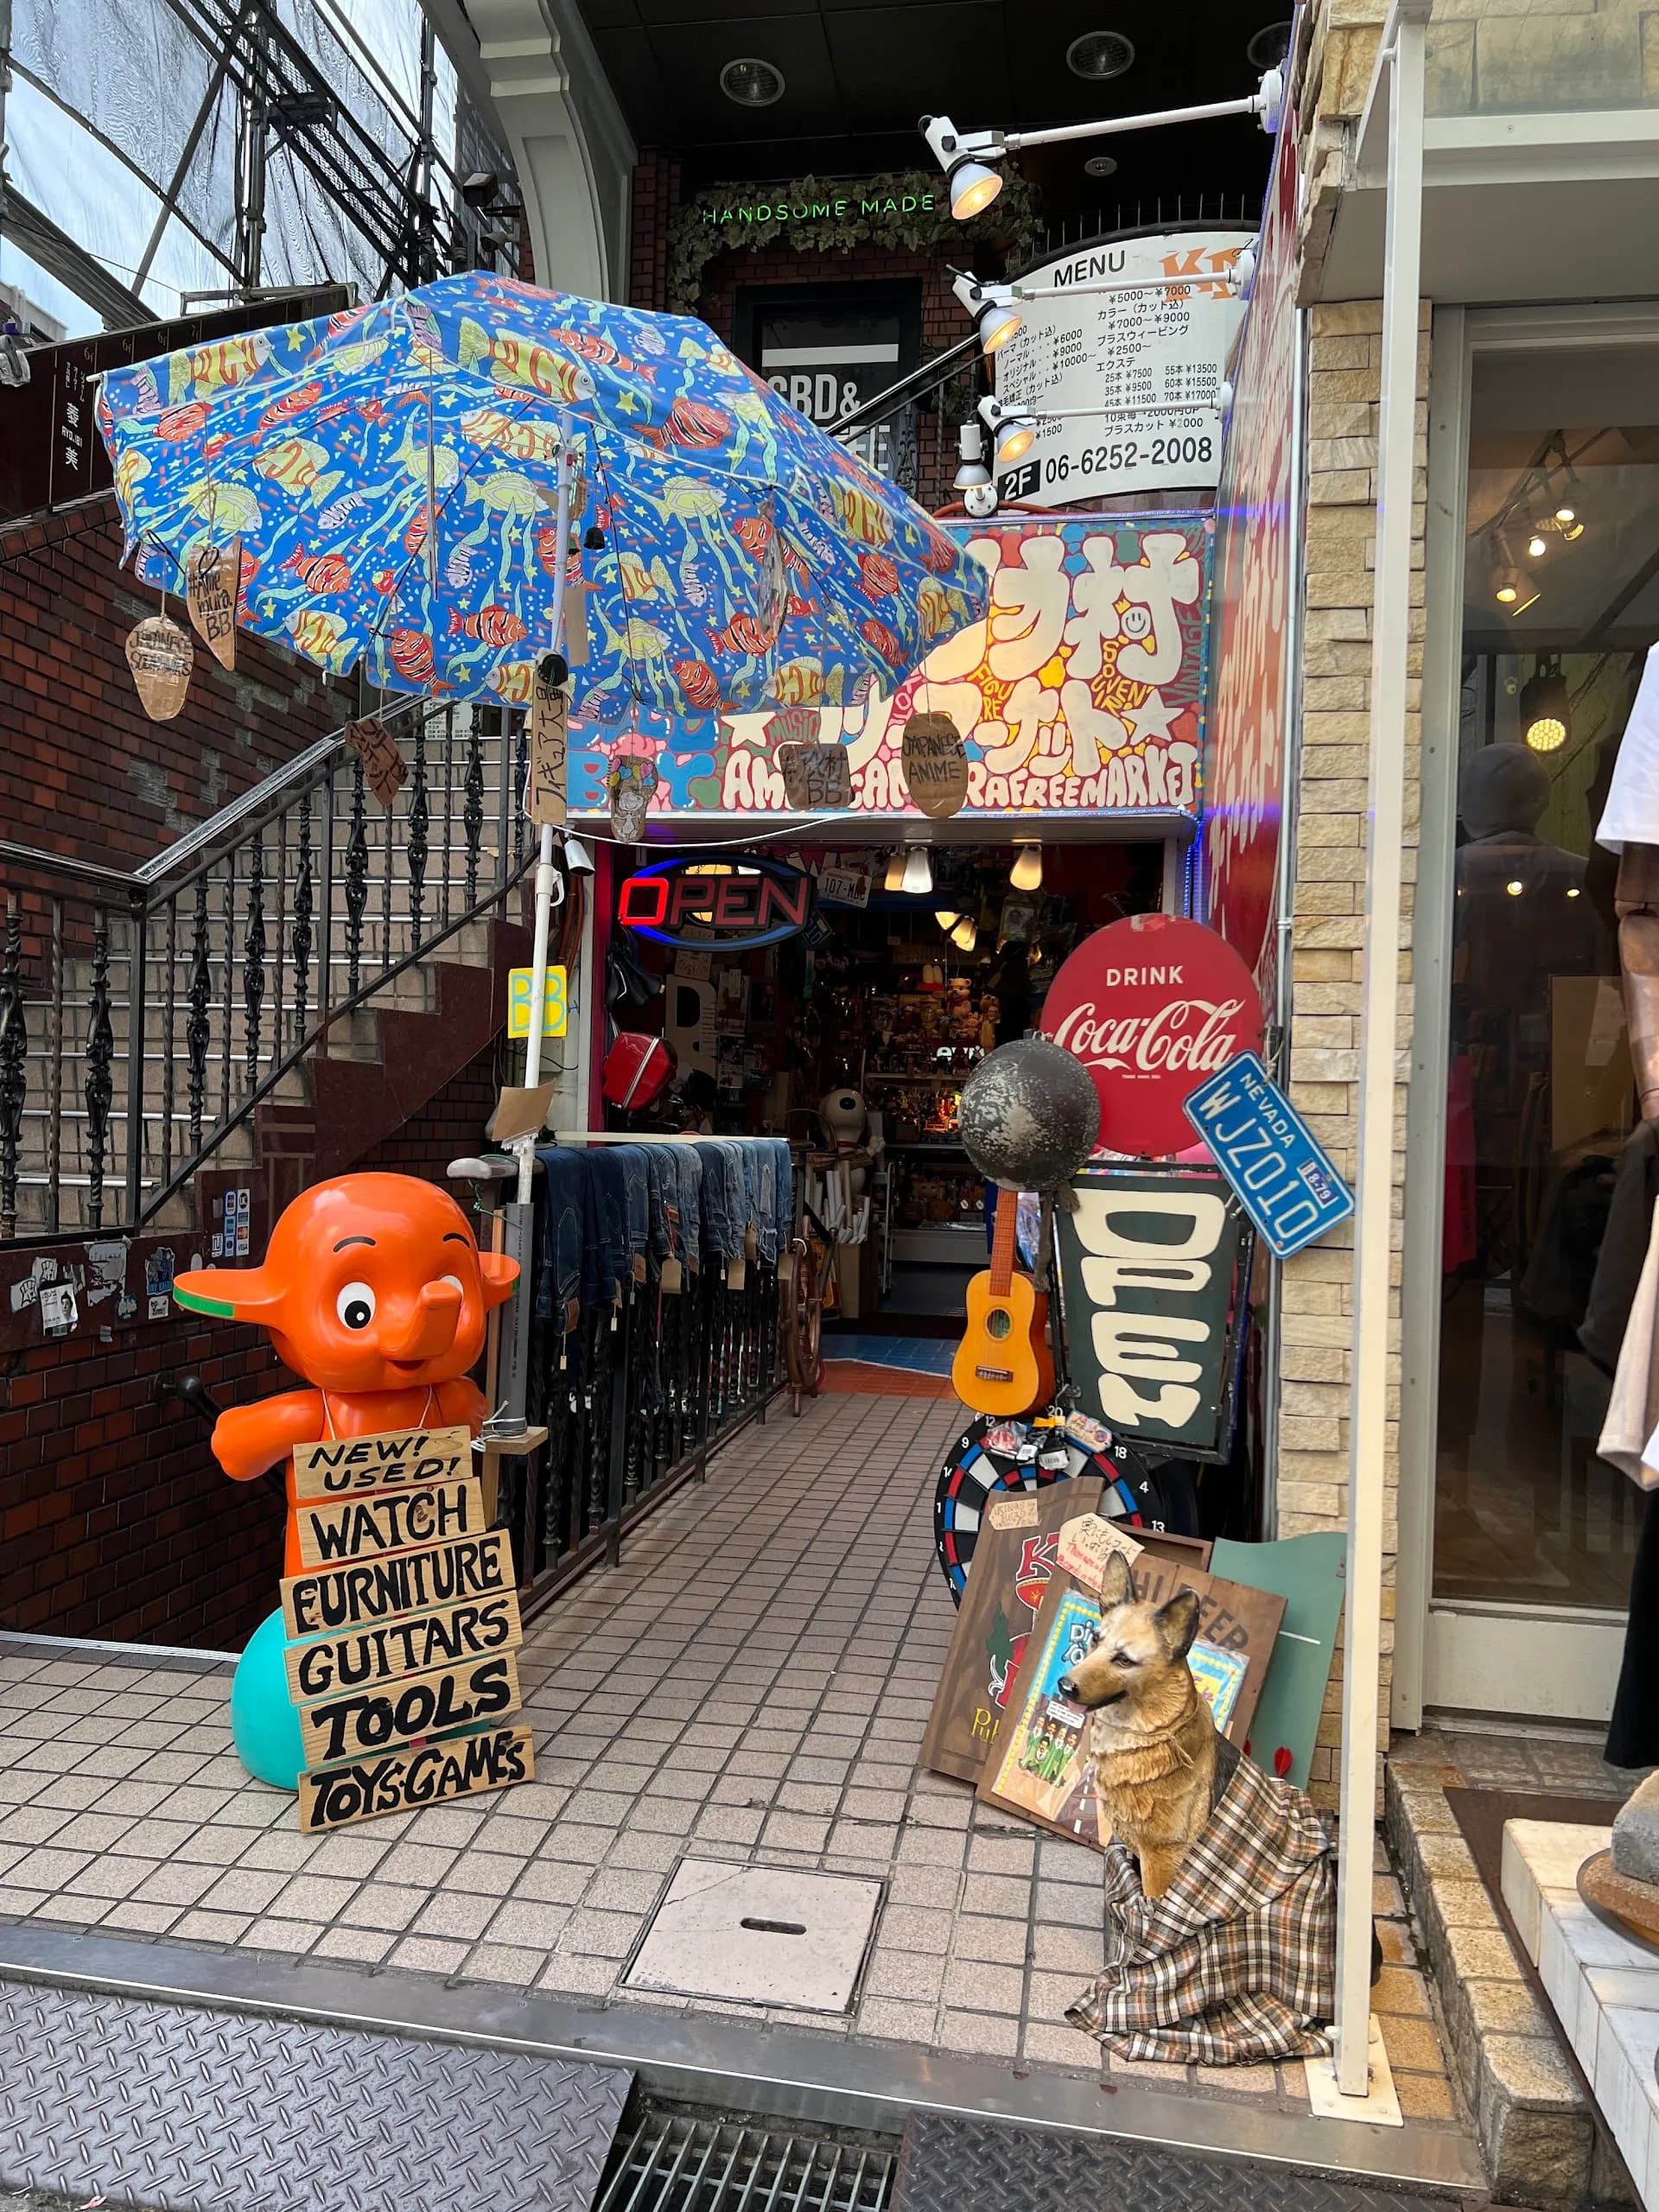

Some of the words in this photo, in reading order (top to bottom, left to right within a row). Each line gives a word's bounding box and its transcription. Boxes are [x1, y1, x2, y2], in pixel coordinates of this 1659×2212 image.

[702, 200, 847, 226] HANDSOME
[861, 195, 935, 216] MADE
[1054, 250, 1126, 288] MENU
[1096, 357, 1135, 372] エクステ
[1004, 472, 1033, 501] 2F
[1046, 436, 1212, 484] 06-6252-2008
[207, 612, 232, 642] BB
[1160, 600, 1204, 708] VINTAGE
[768, 710, 820, 741] MUSIC
[902, 733, 966, 759] JAPANESE
[909, 760, 961, 785] ANIME
[618, 877, 809, 926] OPEN
[1106, 965, 1184, 987] DRINK
[1052, 999, 1246, 1071] Coca-Cola
[1240, 1072, 1296, 1148] NEVADA
[985, 1415, 995, 1427] 12
[1047, 1405, 1064, 1418] 20
[308, 1434, 430, 1469] NEW!
[961, 1436, 969, 1449] 9
[1114, 1446, 1128, 1459] 18
[324, 1456, 460, 1491] USED!
[1139, 1480, 1149, 1494] 4
[310, 1484, 467, 1560] WATCH
[1151, 1520, 1165, 1532] 13
[292, 1536, 503, 1634] FURNITURE
[298, 1599, 509, 1695] GUITARS
[311, 1658, 511, 1761] TOOLS
